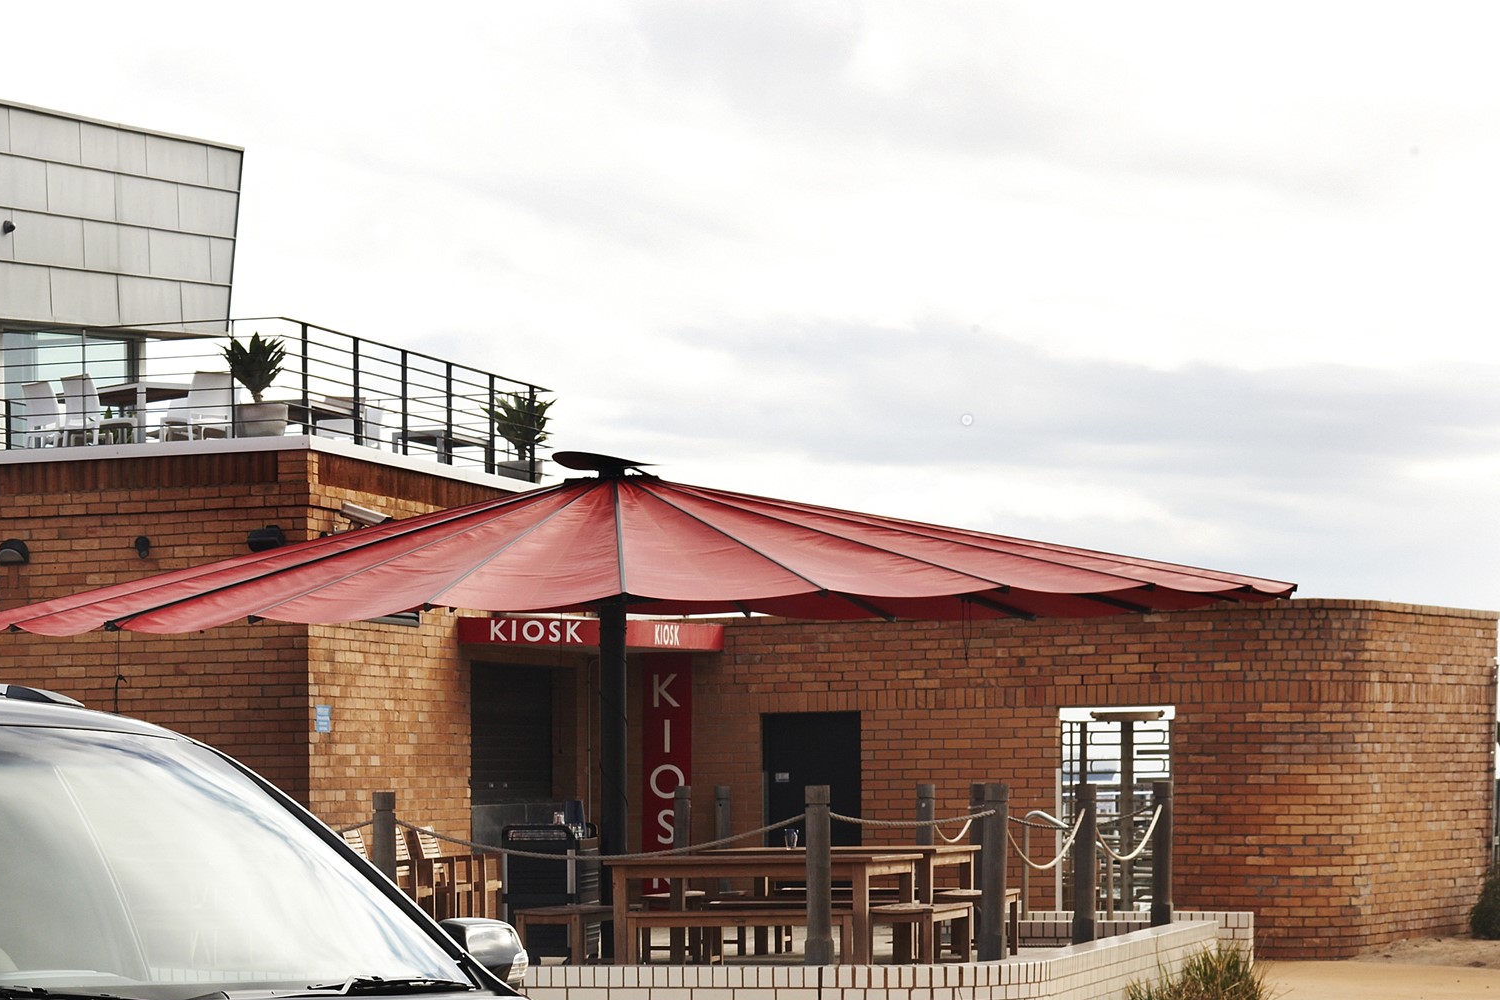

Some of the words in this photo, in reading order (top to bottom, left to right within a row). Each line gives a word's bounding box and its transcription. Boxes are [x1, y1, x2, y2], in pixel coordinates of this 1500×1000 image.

[489, 619, 583, 643] KIOSK
[654, 624, 680, 646] KIOSK
[650, 673, 685, 889] KIOS
